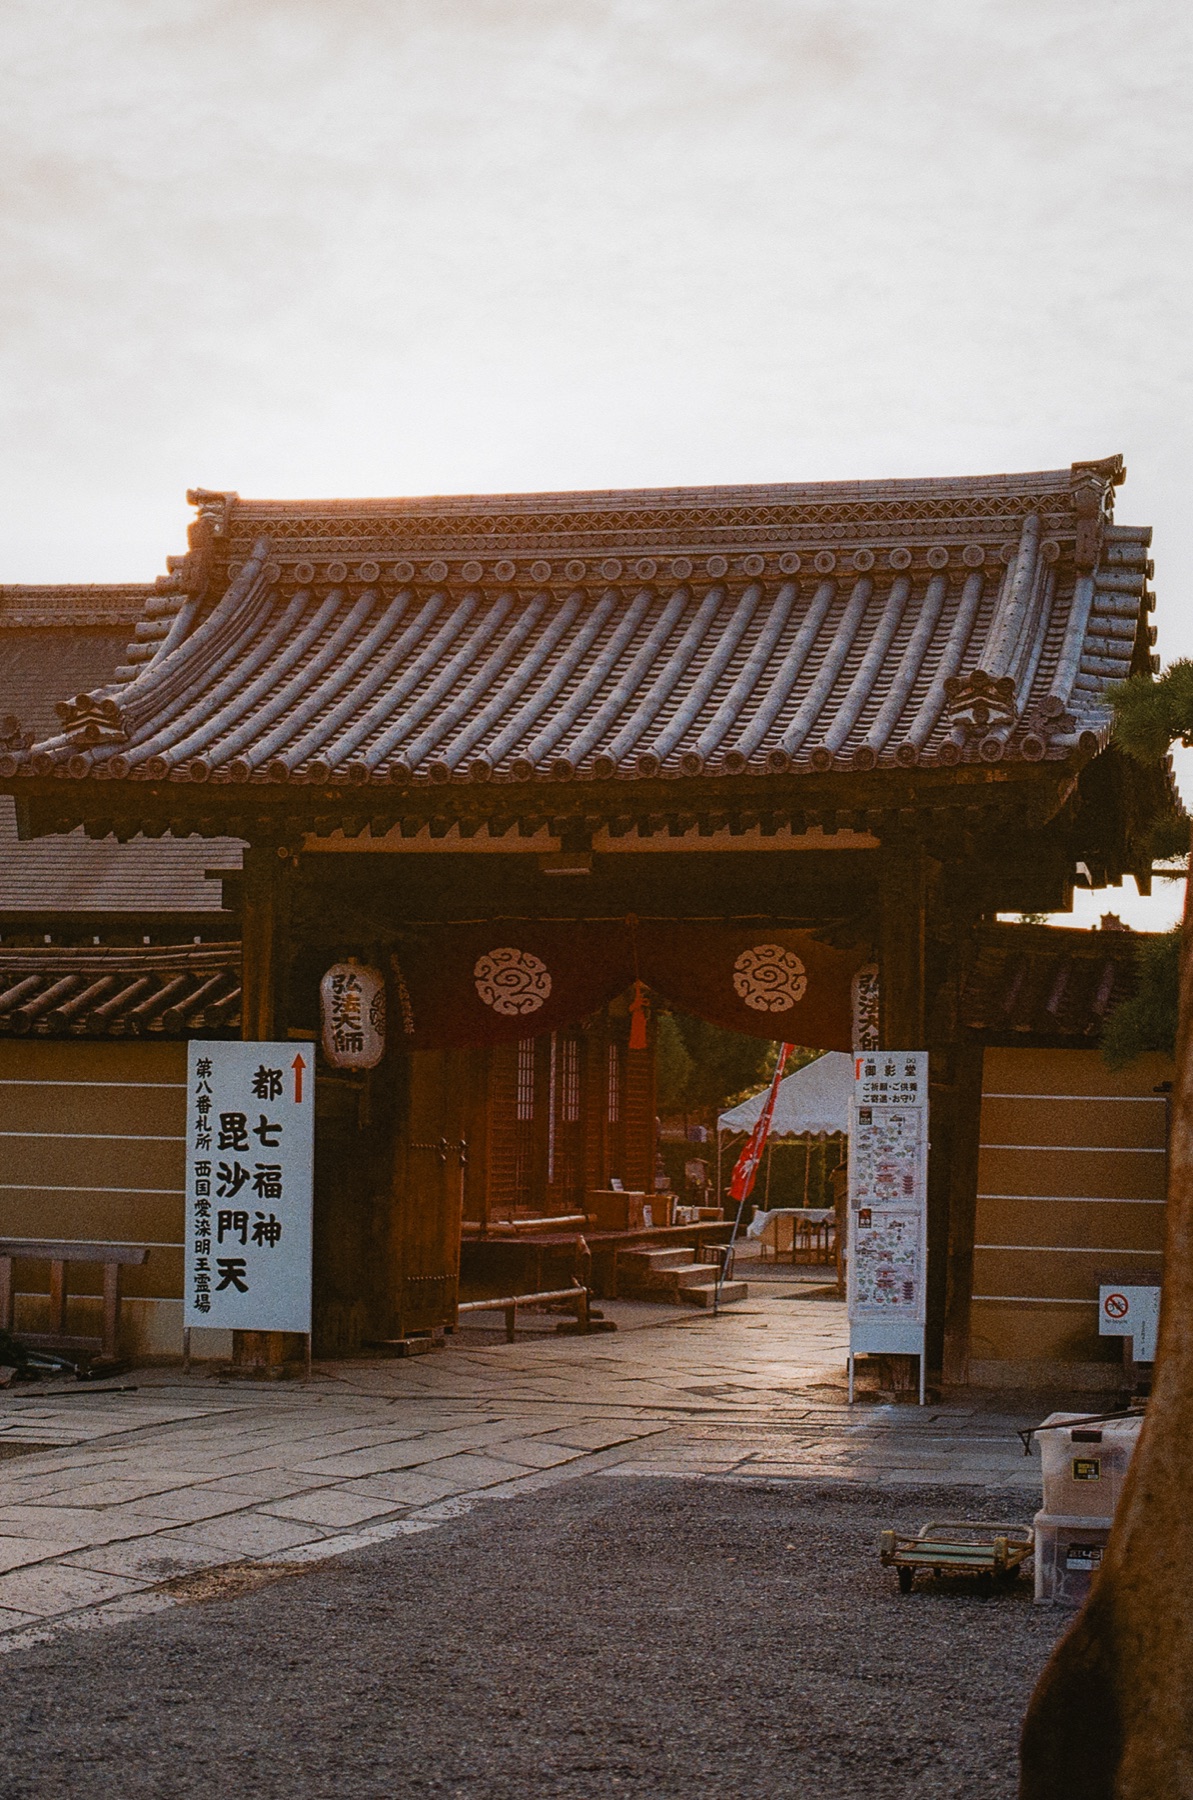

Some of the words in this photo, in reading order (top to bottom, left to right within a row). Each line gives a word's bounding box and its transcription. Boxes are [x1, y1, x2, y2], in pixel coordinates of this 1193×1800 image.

[331, 974, 364, 1053] 弘法大師
[194, 1057, 213, 1152] 第八番札所
[251, 1064, 284, 1249] 都七福神
[193, 1160, 212, 1314] 西国愛染明王霊場
[215, 1112, 250, 1294] 毘沙門天
